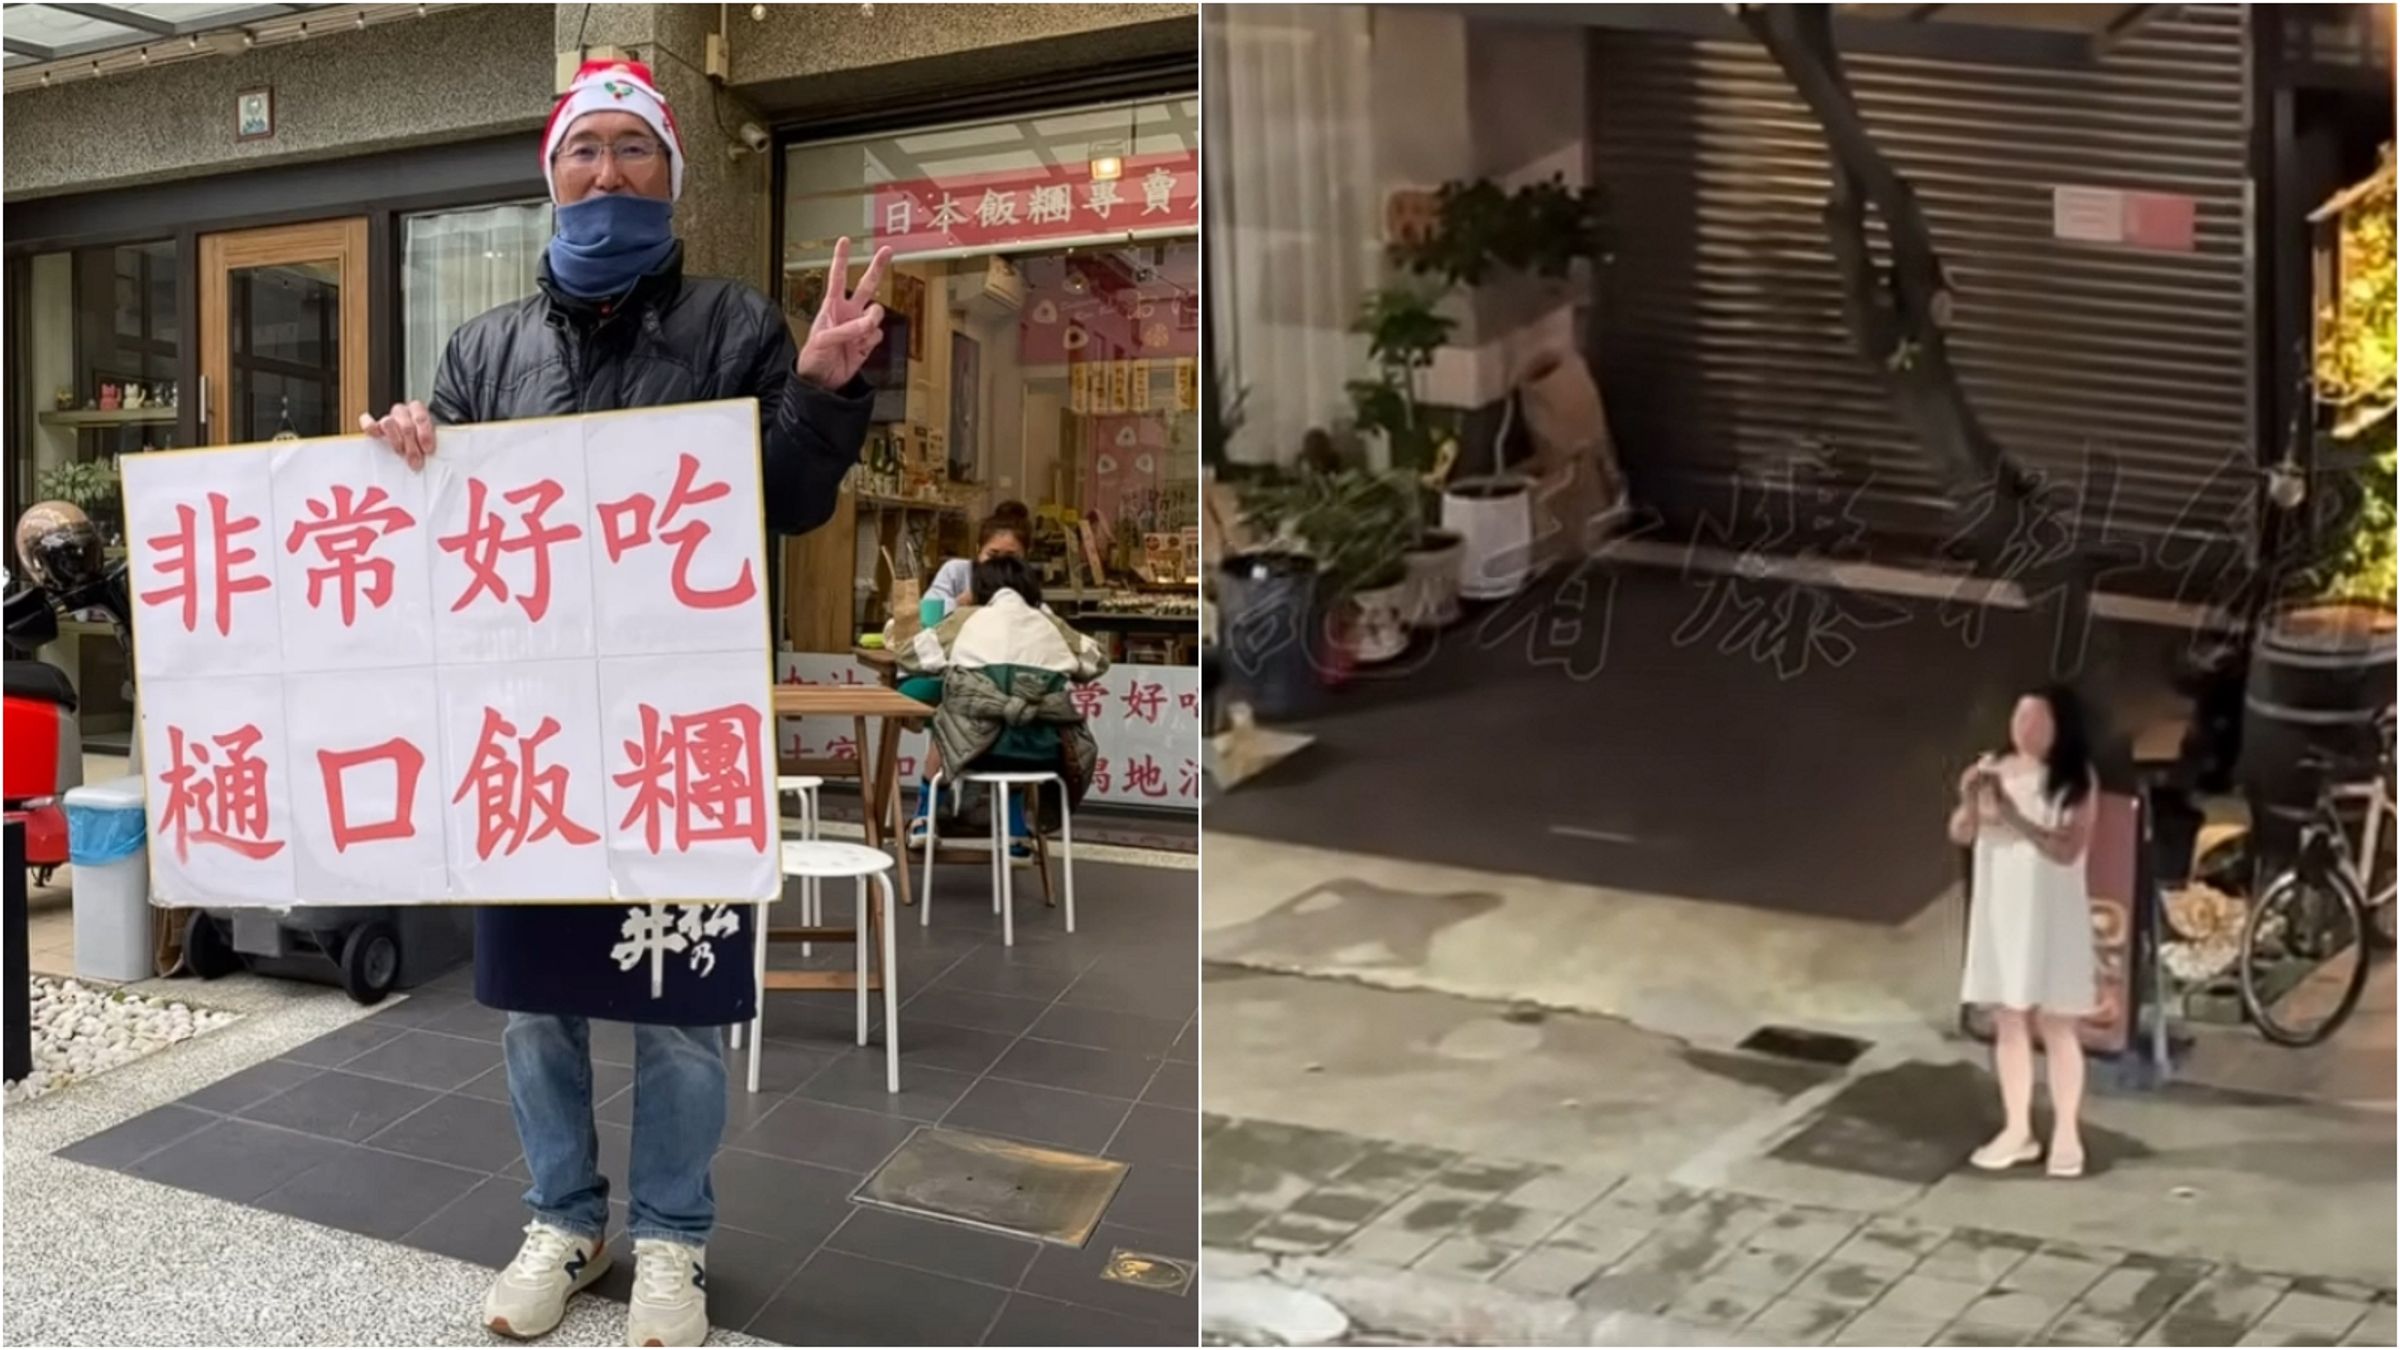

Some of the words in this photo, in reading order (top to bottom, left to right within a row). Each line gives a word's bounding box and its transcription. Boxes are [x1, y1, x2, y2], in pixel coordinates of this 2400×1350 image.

[885, 166, 1197, 235] 日本飯糰專賣
[140, 453, 757, 637] 非常好吃
[158, 703, 766, 865] 樋口飯糰
